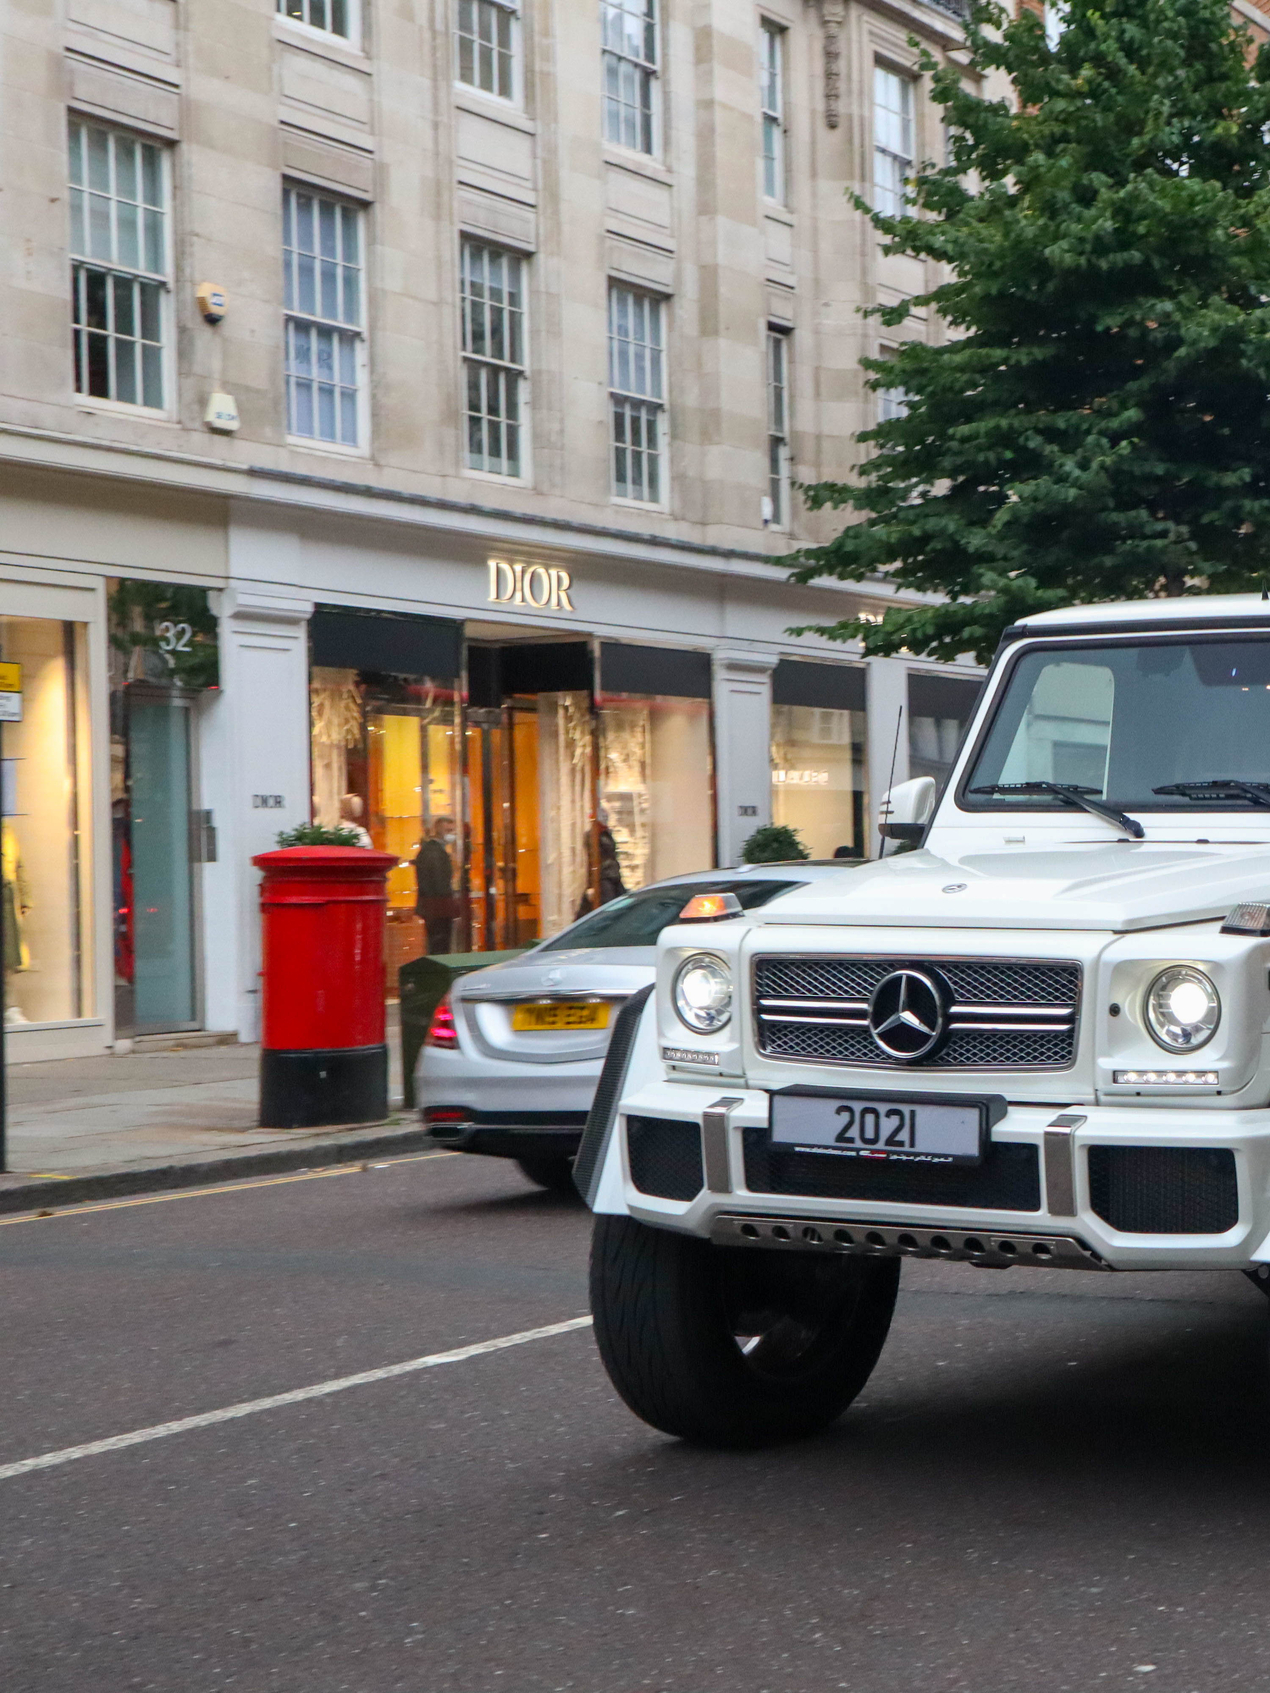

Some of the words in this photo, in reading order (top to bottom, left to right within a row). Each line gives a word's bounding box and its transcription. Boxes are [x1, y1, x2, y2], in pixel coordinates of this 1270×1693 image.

[487, 559, 574, 611] DIOR
[158, 621, 193, 651] 32
[835, 1105, 916, 1149] 2021
